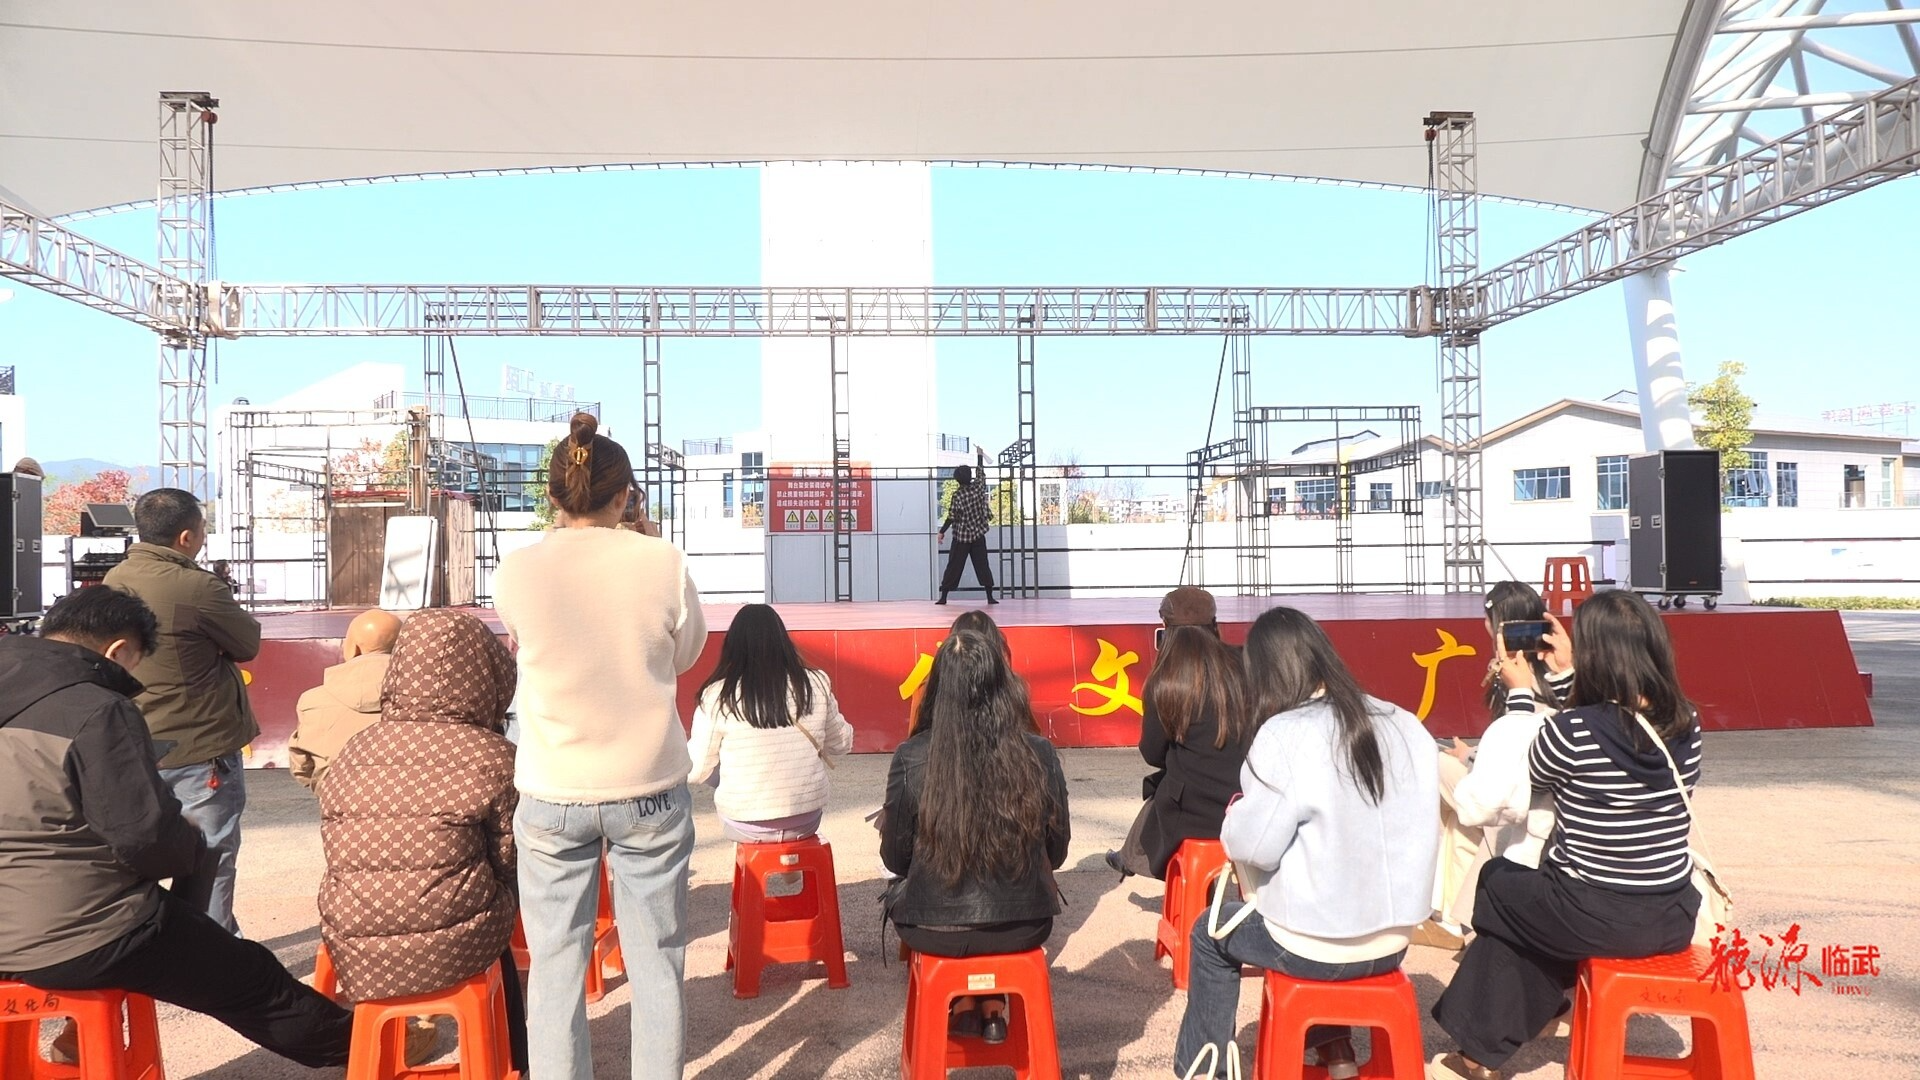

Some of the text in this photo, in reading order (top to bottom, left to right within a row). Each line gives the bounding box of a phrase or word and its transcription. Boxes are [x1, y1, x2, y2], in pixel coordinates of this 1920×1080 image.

[636, 793, 671, 817] LOVE
[4, 993, 59, 1014] 文化局
